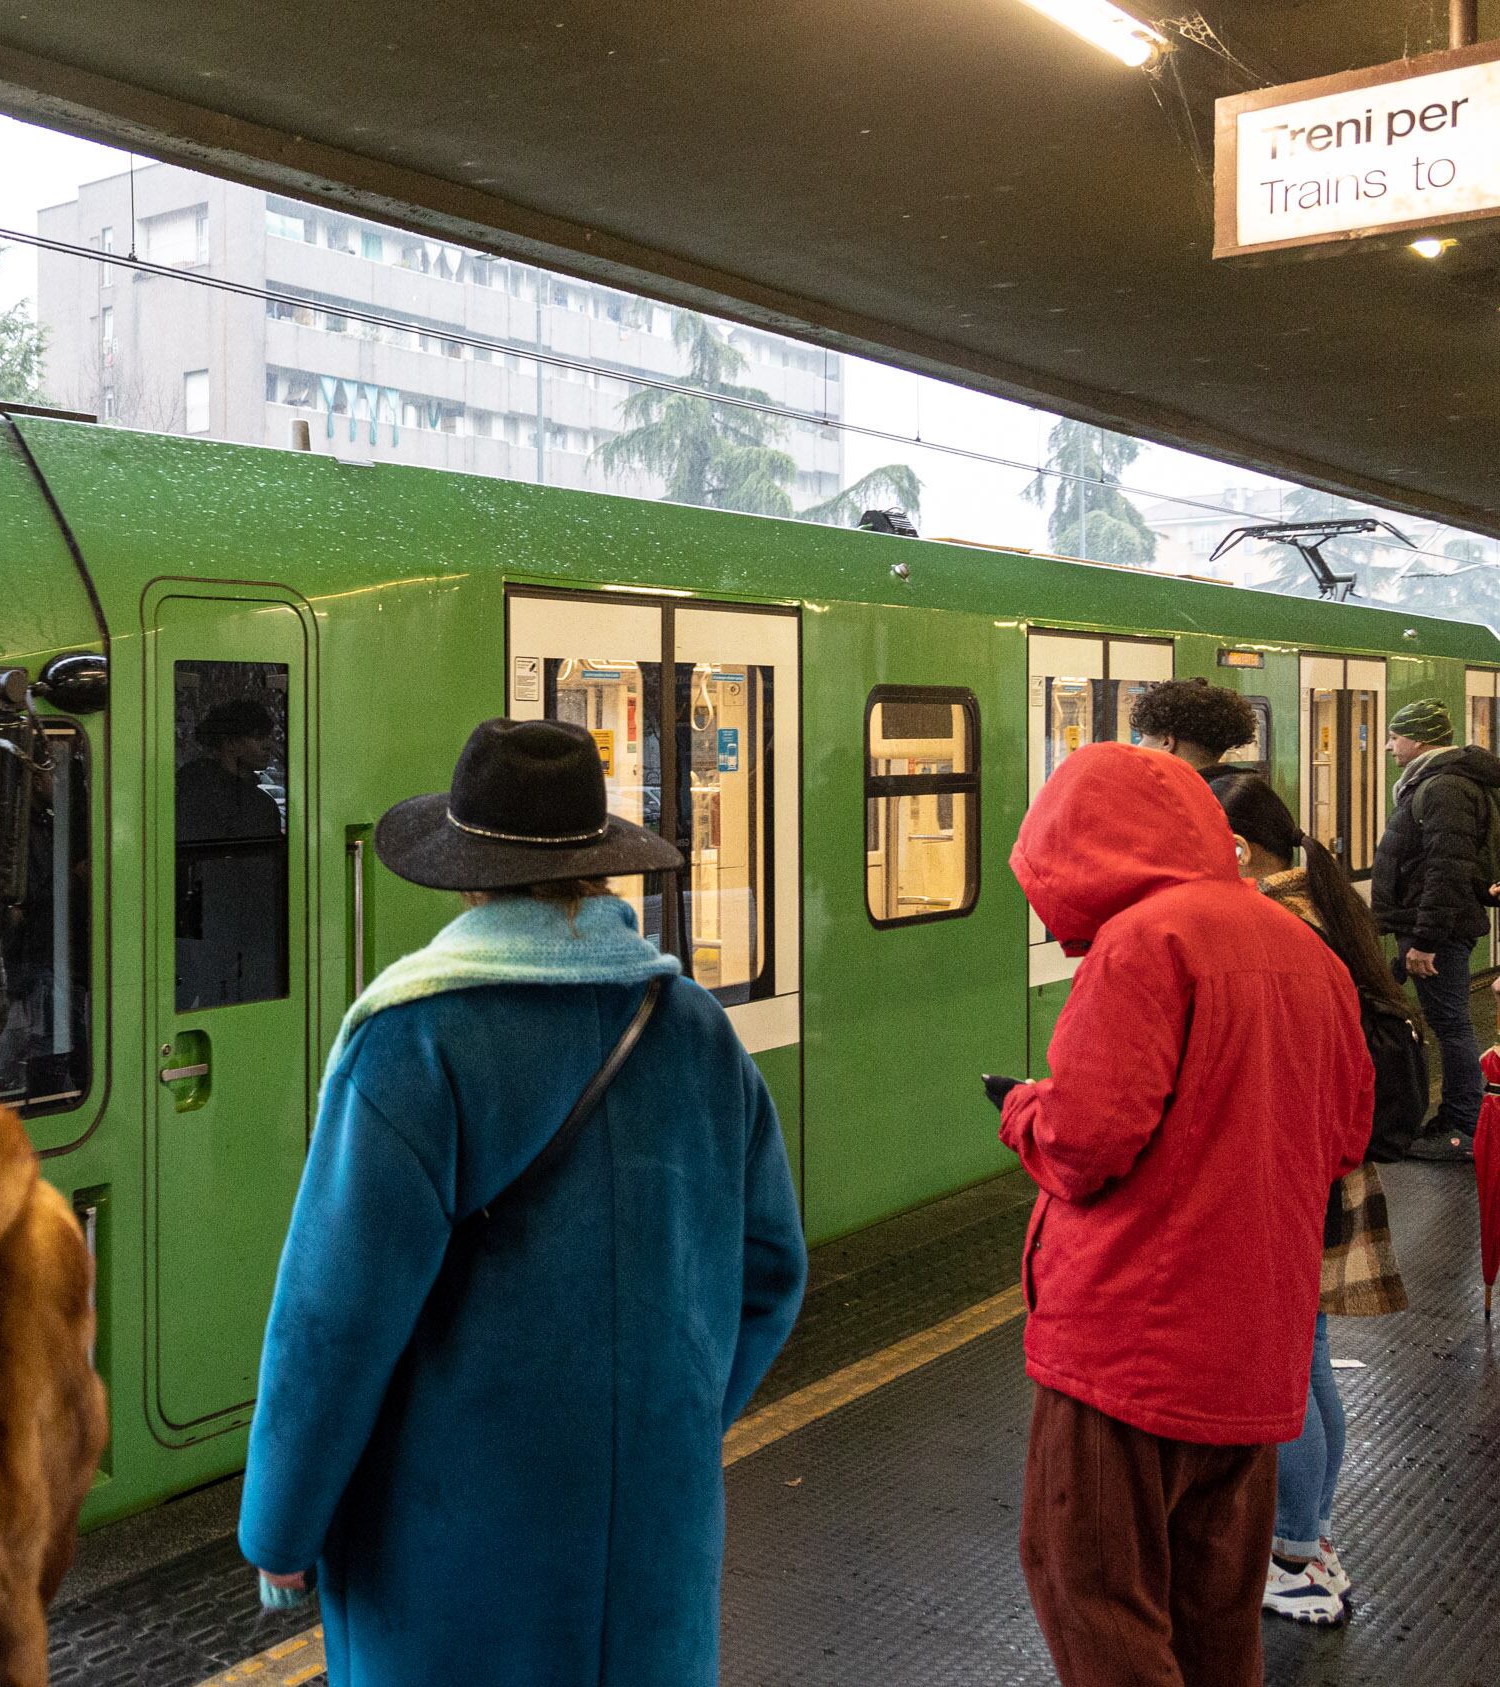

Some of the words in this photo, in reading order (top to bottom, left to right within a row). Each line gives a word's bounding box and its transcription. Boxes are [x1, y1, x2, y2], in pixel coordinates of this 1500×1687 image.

[1261, 108, 1372, 160] Treni
[1386, 97, 1470, 146] per
[1260, 169, 1388, 215] Trains
[1411, 156, 1457, 192] to
